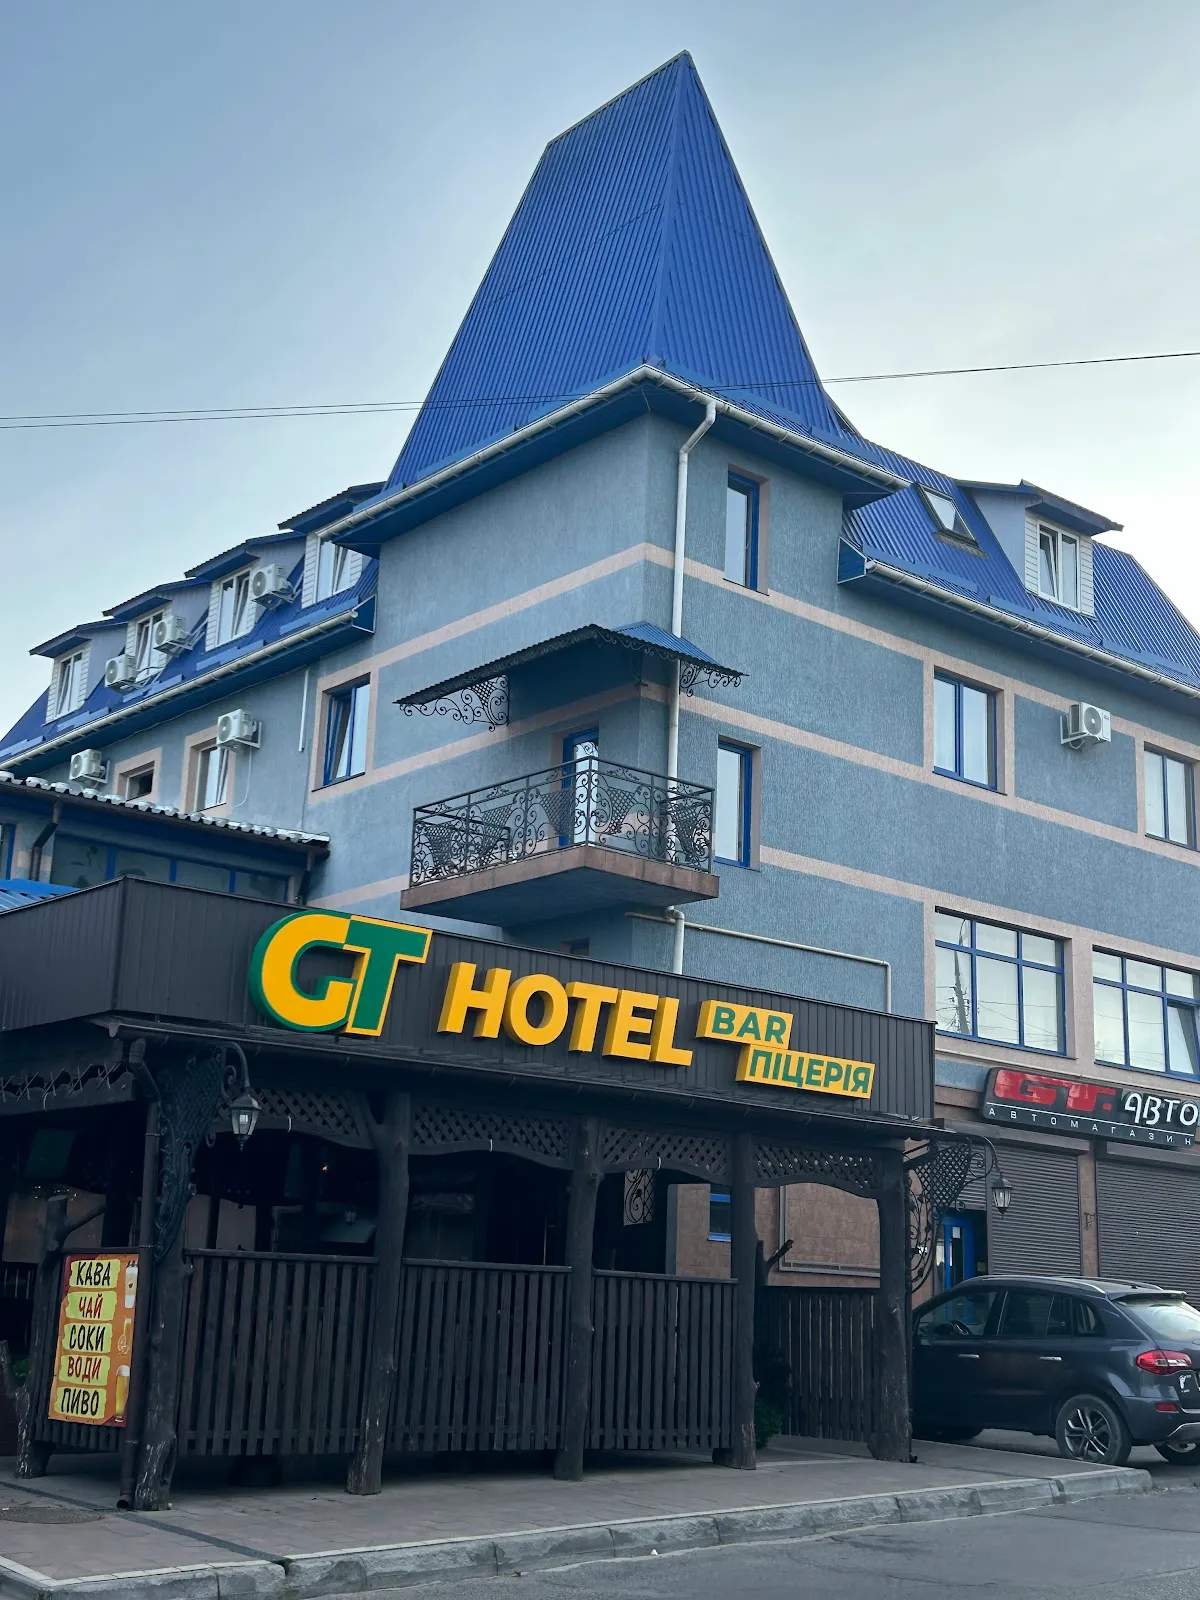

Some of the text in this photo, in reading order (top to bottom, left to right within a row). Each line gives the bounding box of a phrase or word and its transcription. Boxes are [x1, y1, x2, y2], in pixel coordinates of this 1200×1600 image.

[250, 908, 693, 1066] GT HOTEL
[712, 1006, 787, 1044] BAR
[750, 1049, 871, 1093] ПІЦЕРІЯ
[988, 1107, 1191, 1146] АВТОМАГАЗИН
[76, 1261, 111, 1287] КАВА
[78, 1294, 104, 1319] ЧАЙ
[69, 1325, 105, 1352] СОКИ
[67, 1356, 102, 1384] ВОДИ
[61, 1388, 100, 1417] ПИВО
